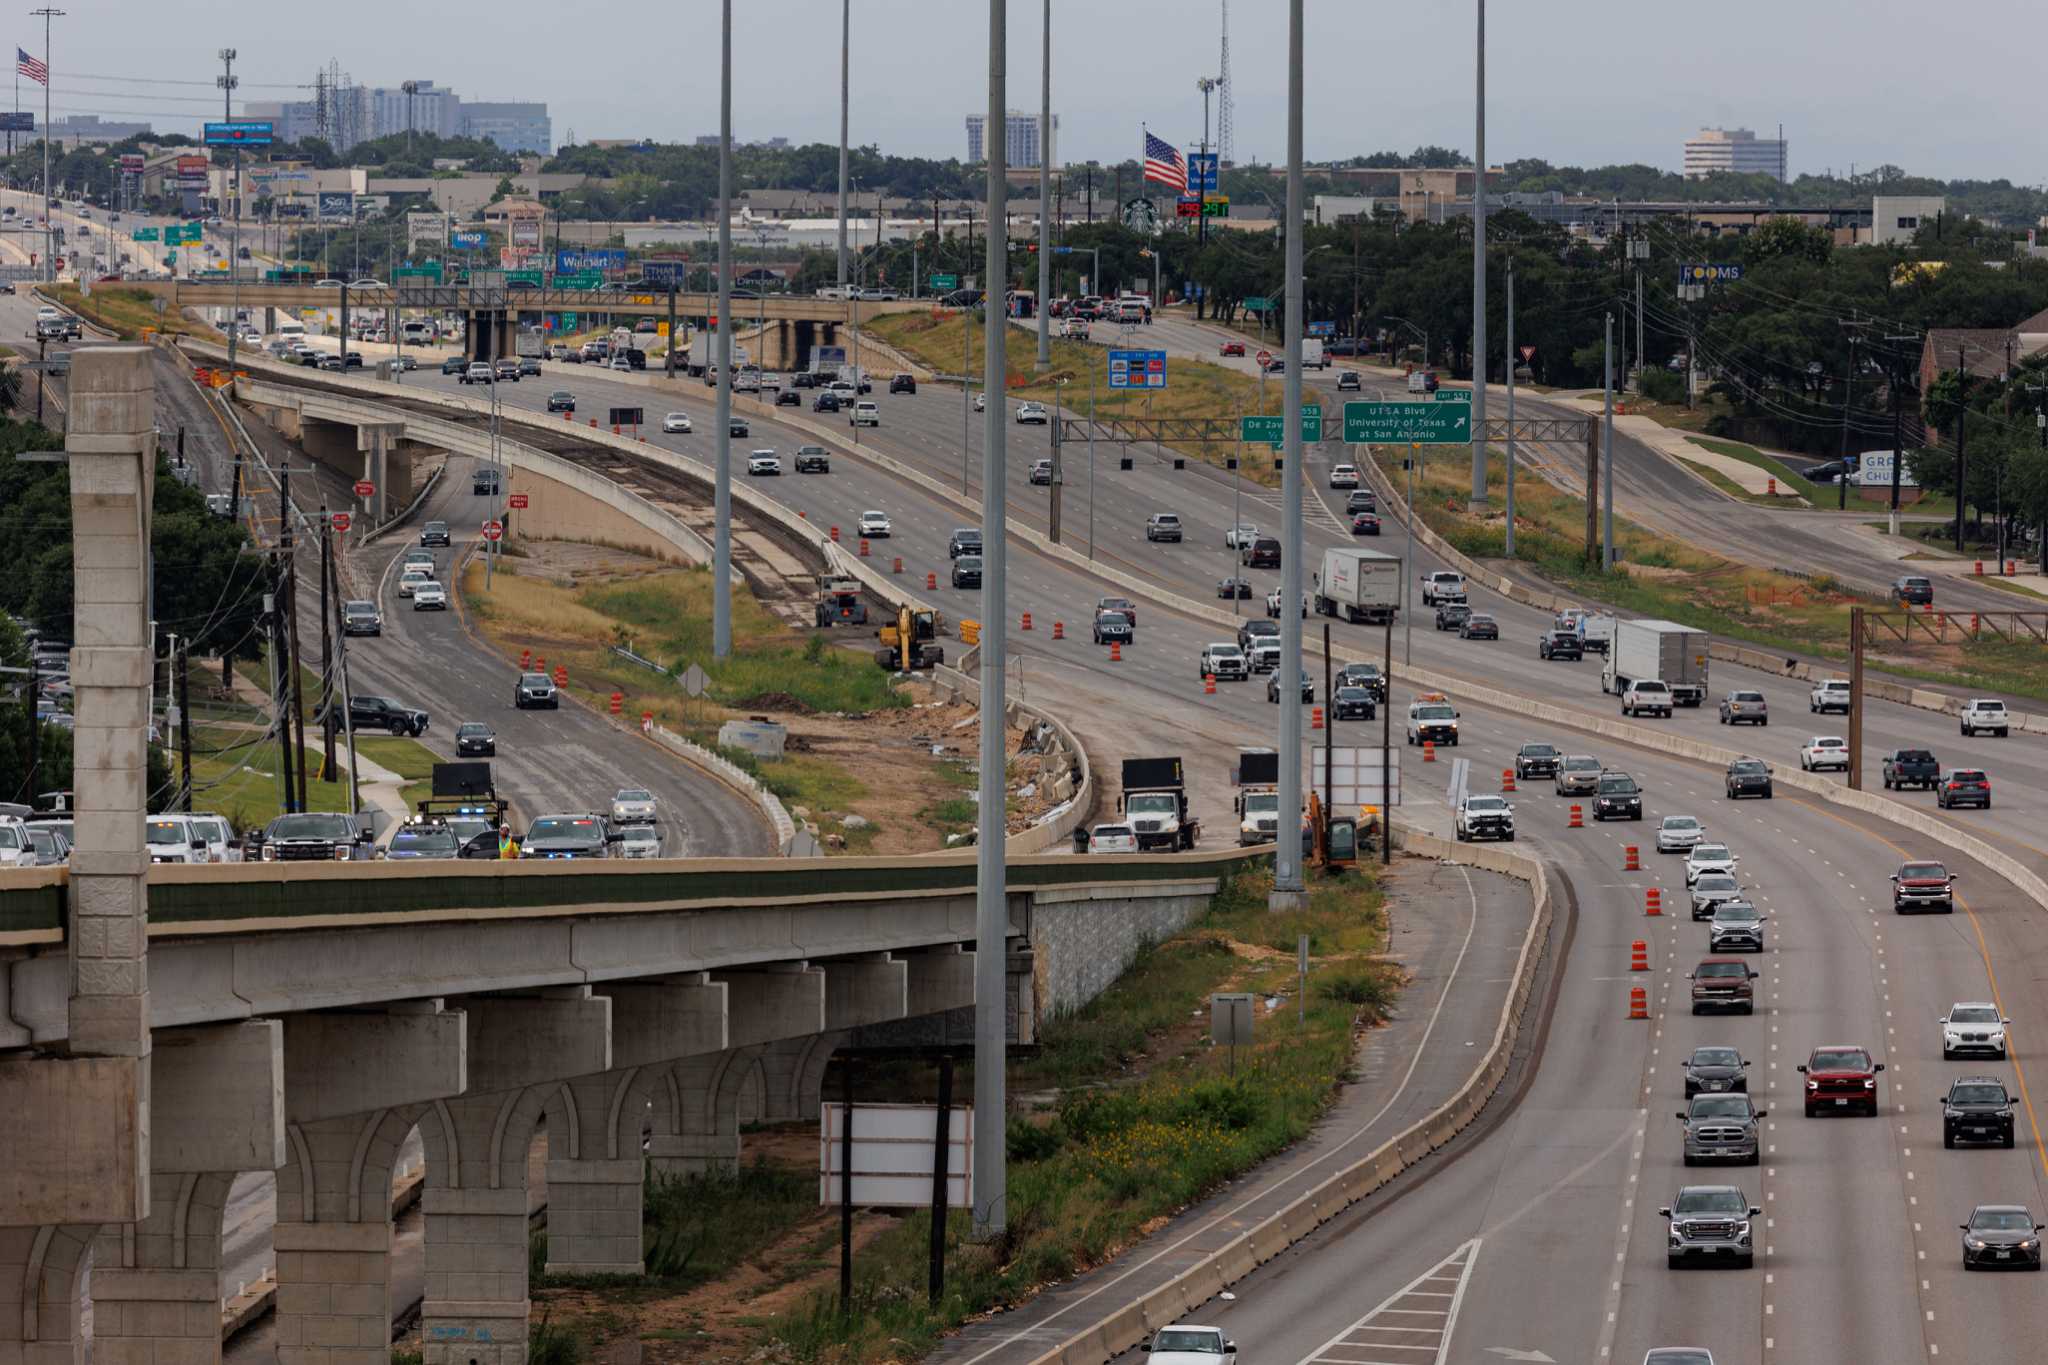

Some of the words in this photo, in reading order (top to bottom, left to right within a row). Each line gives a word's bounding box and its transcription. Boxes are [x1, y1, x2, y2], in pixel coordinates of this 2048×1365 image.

[563, 256, 608, 268] Walmart
[1684, 266, 1739, 279] ROOMS
[1404, 407, 1425, 415] Blvd
[1248, 420, 1261, 429] De
[1303, 420, 1316, 429] Rd
[1349, 418, 1400, 428] University
[1403, 418, 1414, 427] of
[1418, 418, 1447, 427] Texas
[1359, 431, 1370, 439] at
[1374, 430, 1392, 438] San
[1866, 471, 1912, 481] CHUCH
